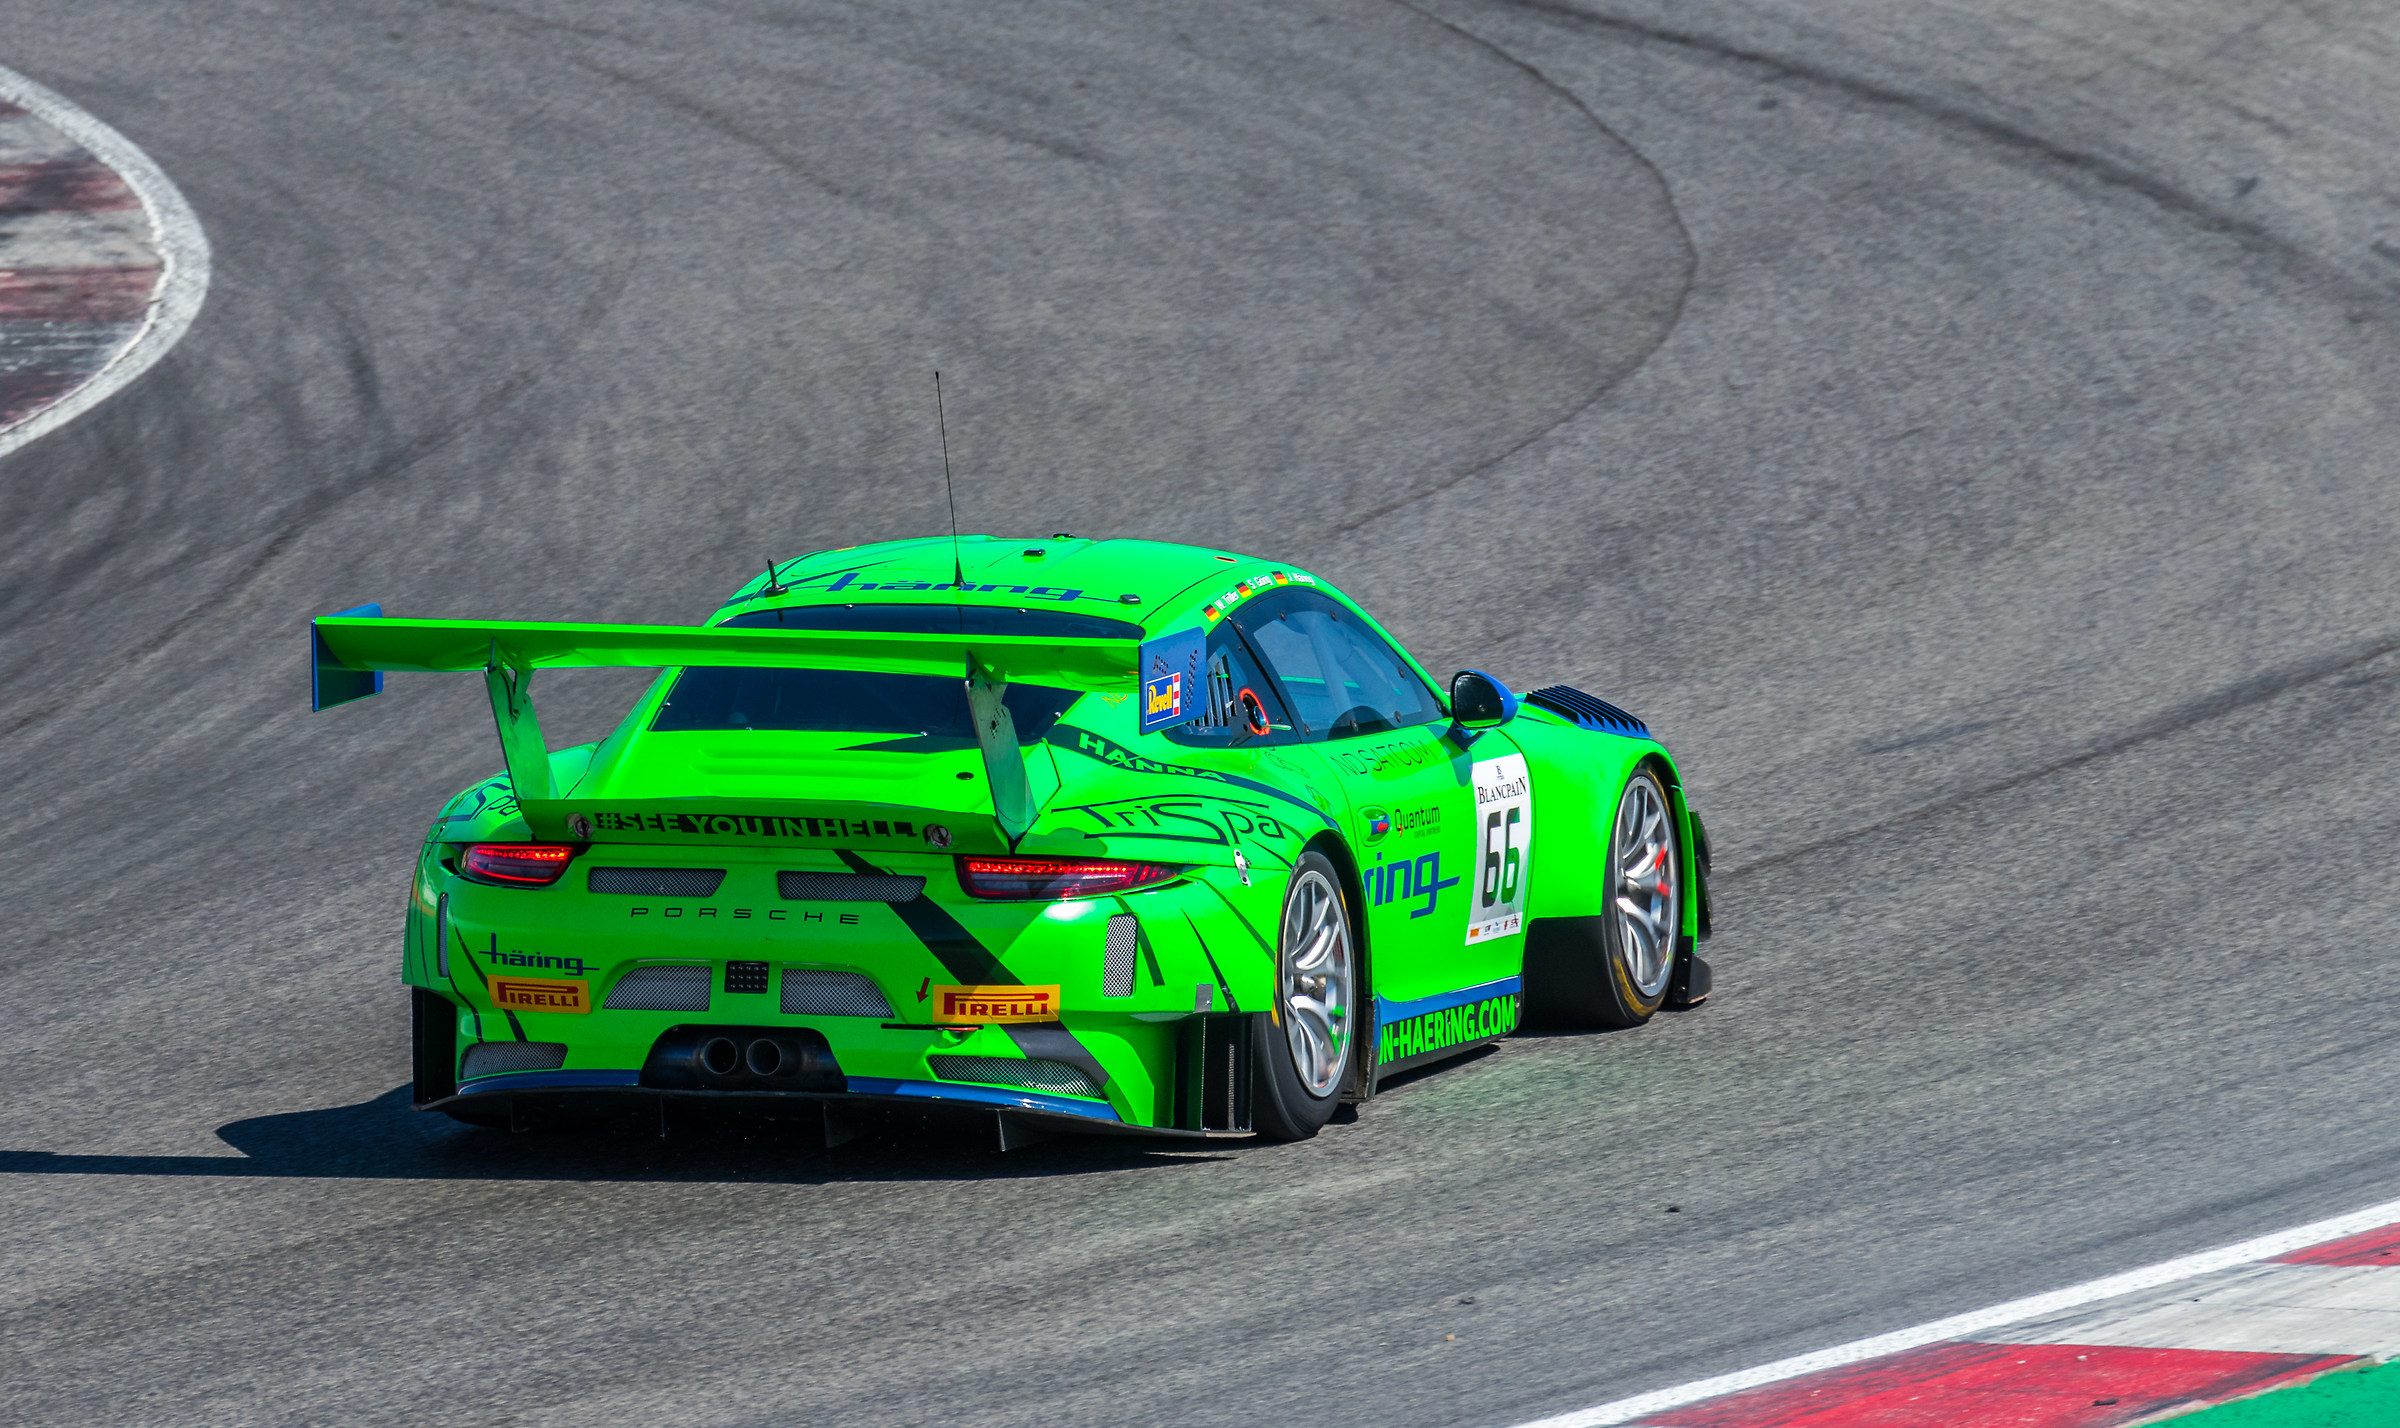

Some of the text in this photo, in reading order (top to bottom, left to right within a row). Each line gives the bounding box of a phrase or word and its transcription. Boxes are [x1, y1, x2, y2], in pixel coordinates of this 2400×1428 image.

[1148, 685, 1173, 715] Revell
[1078, 732, 1228, 783] HANNA
[1477, 775, 1528, 805] BLANCPAIN
[597, 812, 681, 833] #SEE
[686, 815, 766, 837] YOU
[772, 817, 811, 837] IN
[1394, 805, 1441, 836] Quantum
[1481, 806, 1521, 909] 66
[630, 906, 860, 925] PORSCHE
[478, 932, 600, 976] häring
[496, 981, 580, 1007] PIRELLI
[943, 992, 1050, 1016] PIRELLI
[1378, 994, 1516, 1066] N-HAERING.COM
